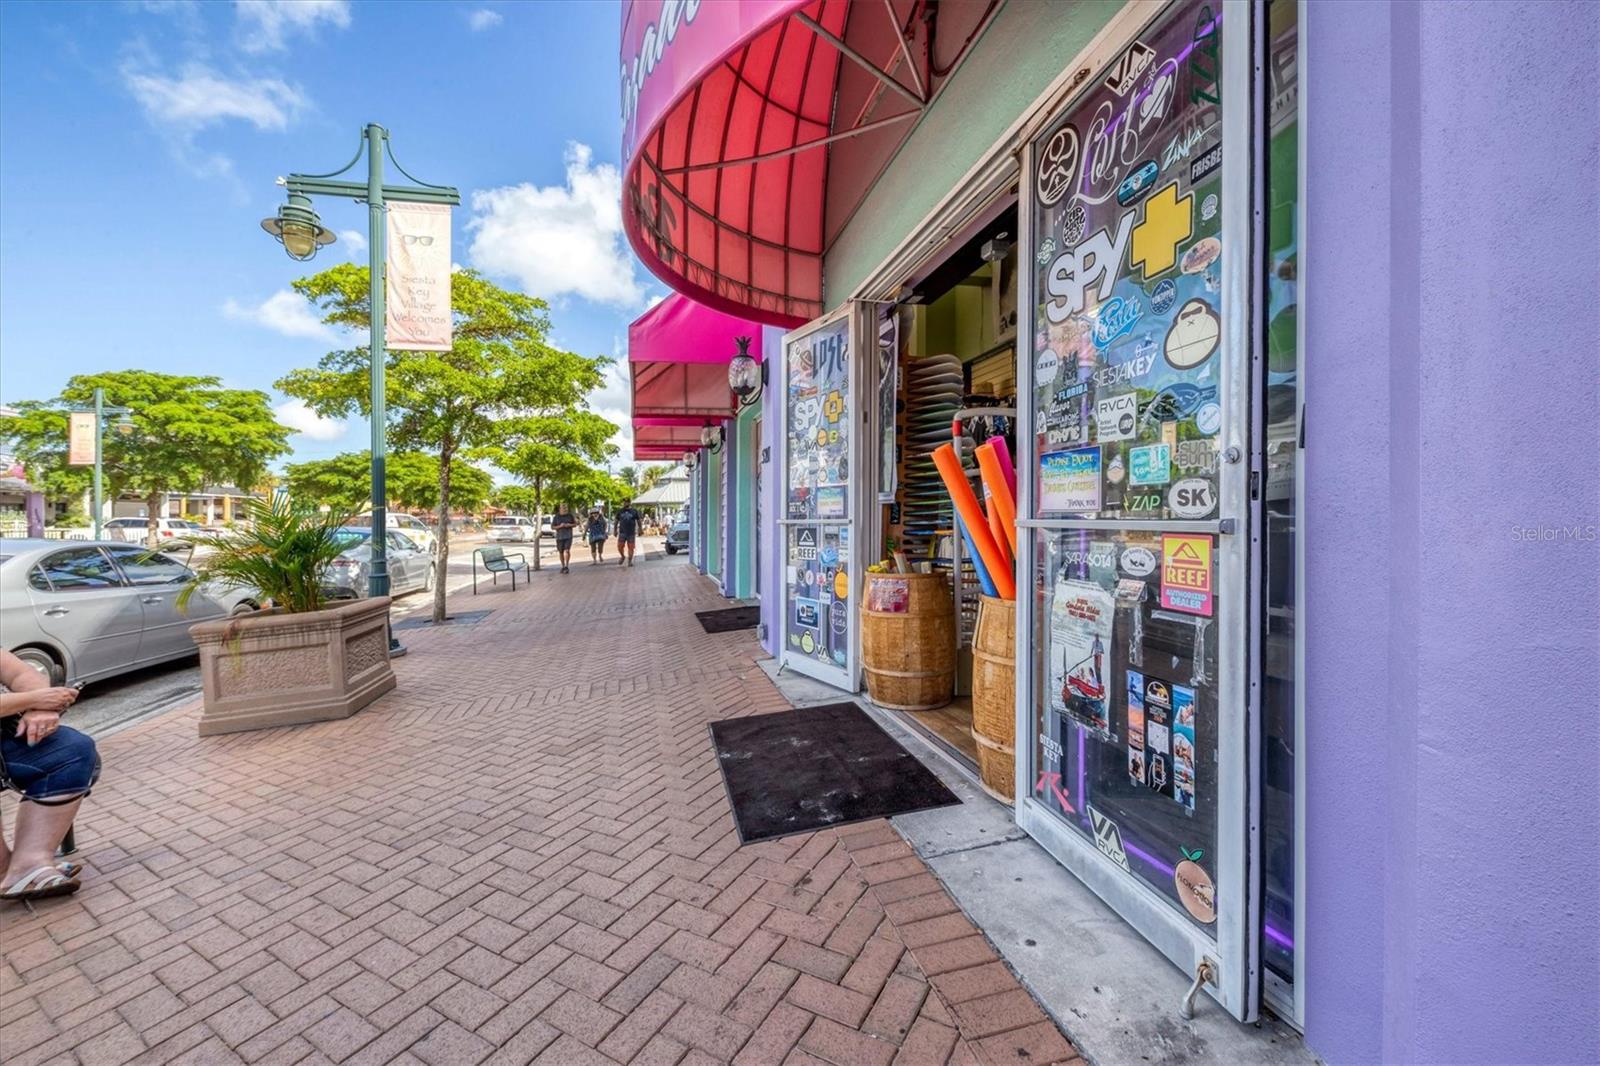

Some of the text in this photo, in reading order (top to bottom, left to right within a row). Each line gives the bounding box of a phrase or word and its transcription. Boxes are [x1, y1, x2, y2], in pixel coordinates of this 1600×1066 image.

[1047, 208, 1137, 323] SPY
[407, 287, 430, 300] Key
[408, 326, 430, 338] You
[1059, 383, 1088, 401] FLORIDA
[794, 394, 826, 430] SPY
[1100, 397, 1134, 413] RVCA
[1131, 495, 1161, 511] ZAP
[1177, 488, 1208, 508] SK
[798, 547, 816, 559] REEF
[1166, 567, 1207, 587] REEF
[1170, 596, 1202, 610] DEALER
[1040, 733, 1064, 757] SIESTA
[1043, 746, 1058, 764] KEY
